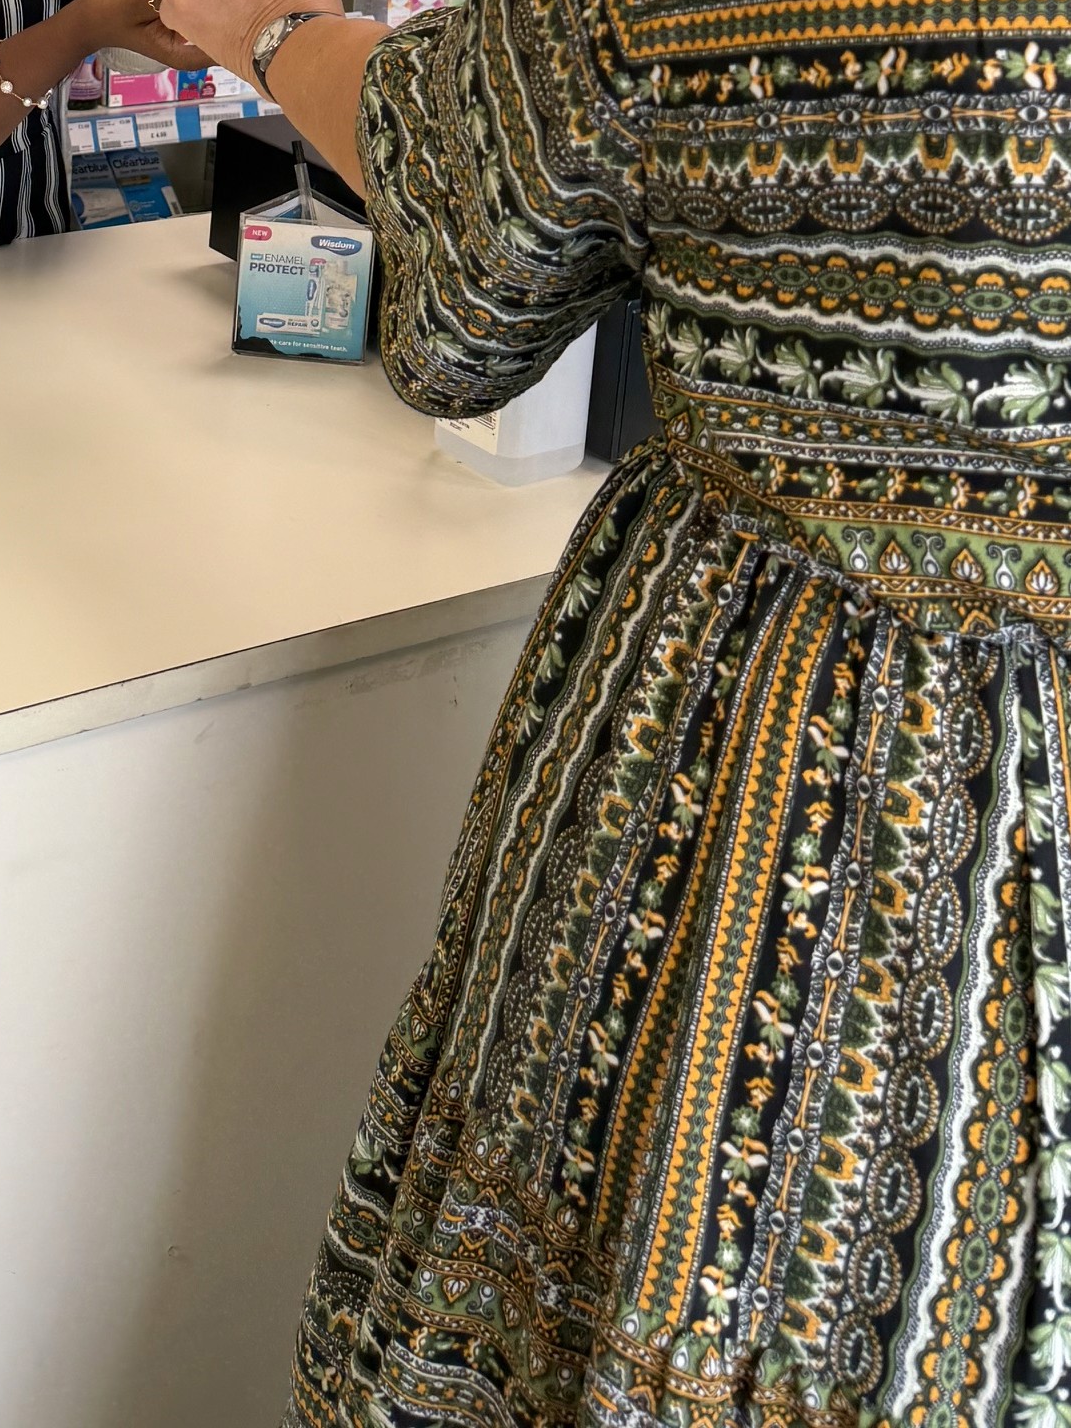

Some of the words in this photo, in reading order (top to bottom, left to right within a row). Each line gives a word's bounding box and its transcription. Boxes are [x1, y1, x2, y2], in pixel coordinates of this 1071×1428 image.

[112, 155, 160, 168] Clearblue
[319, 238, 354, 251] Wisdom
[265, 254, 303, 265] ENAMEL
[250, 263, 305, 275] PROTECT
